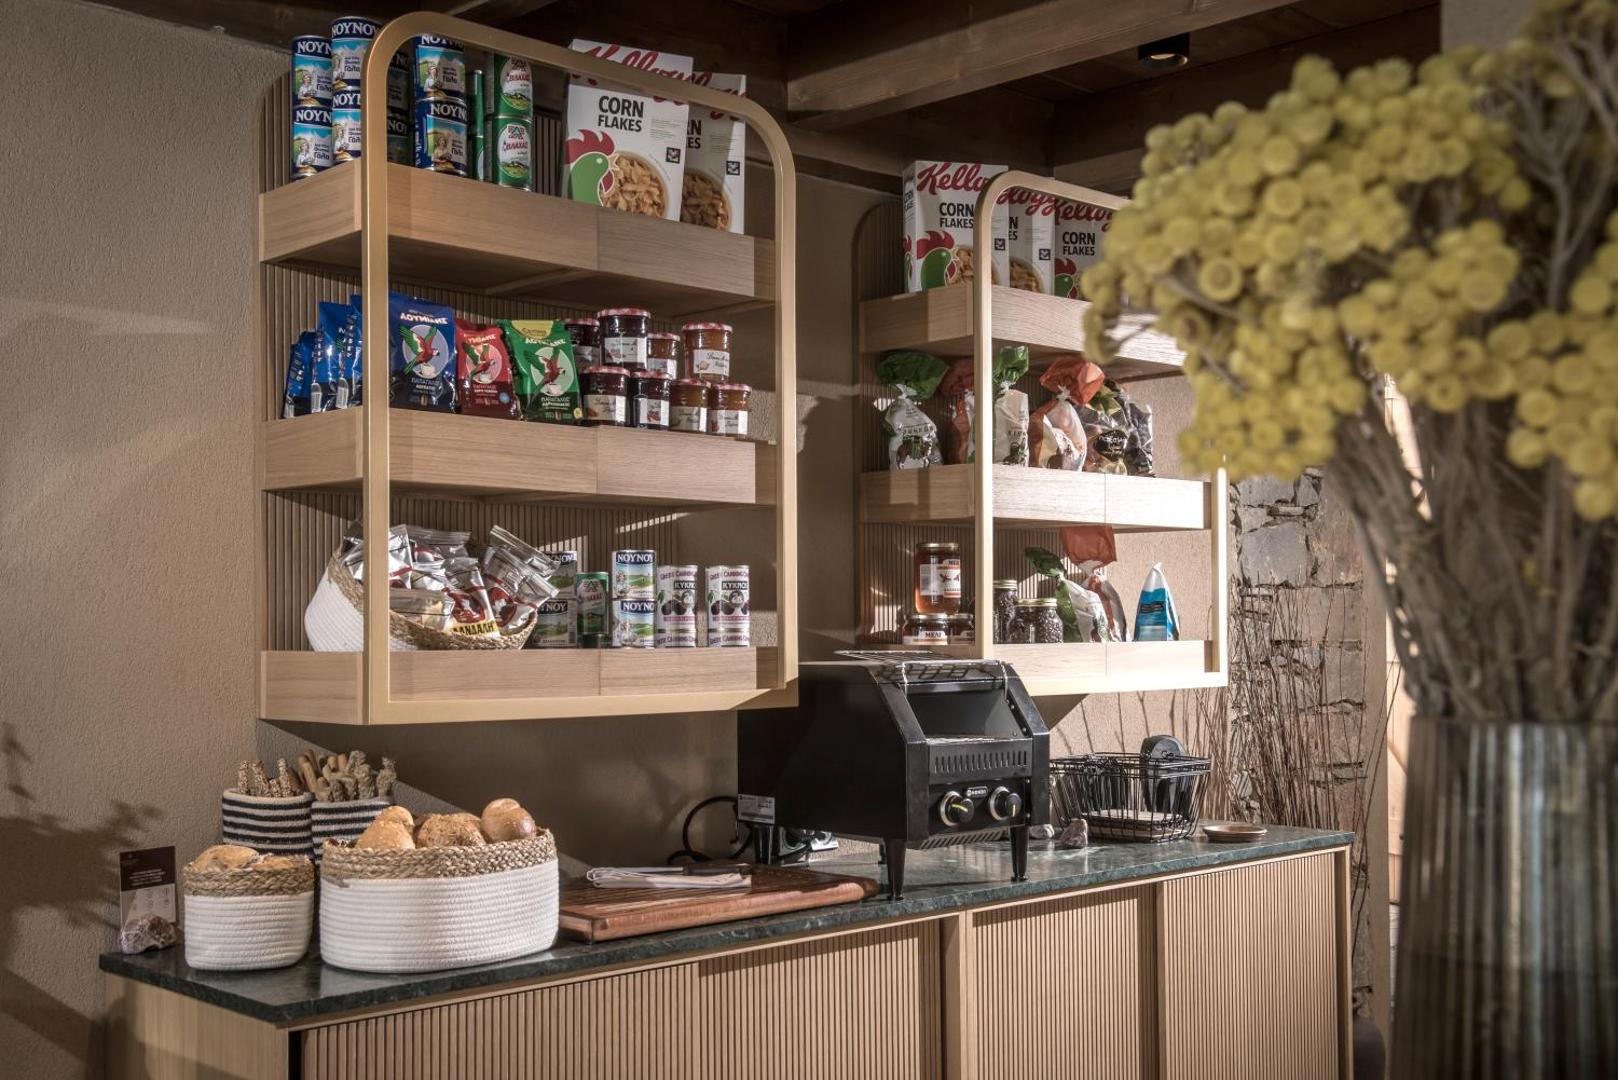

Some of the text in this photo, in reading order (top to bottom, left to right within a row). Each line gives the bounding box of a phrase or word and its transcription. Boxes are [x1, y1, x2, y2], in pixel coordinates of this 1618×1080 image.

[599, 95, 644, 118] CORN
[598, 115, 642, 132] FLAKES
[917, 162, 987, 195] Kello
[939, 203, 974, 217] CORN
[940, 218, 974, 228] FLAKES
[1063, 232, 1095, 246] CORN
[1063, 245, 1095, 256] FLAKES
